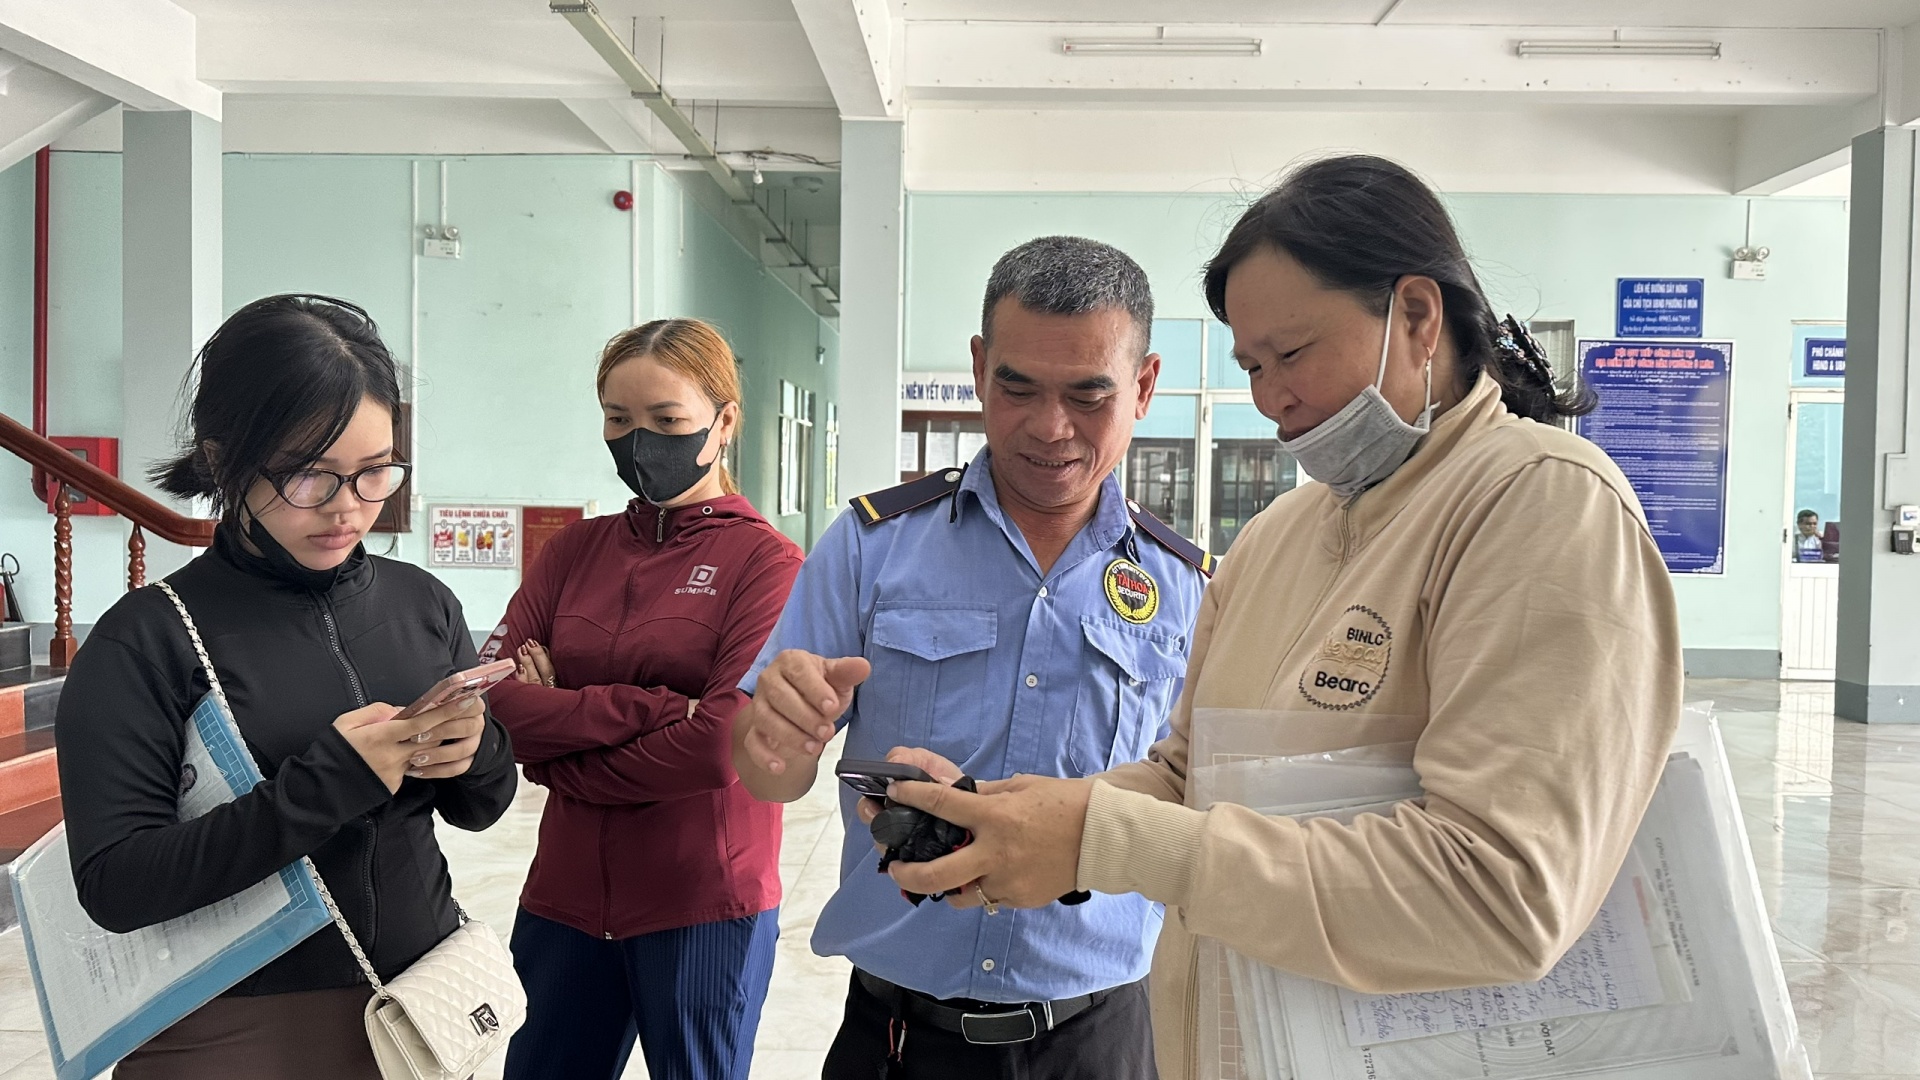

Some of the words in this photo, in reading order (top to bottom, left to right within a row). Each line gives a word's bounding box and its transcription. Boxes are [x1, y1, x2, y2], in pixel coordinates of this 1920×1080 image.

[906, 381, 924, 400] NIÊM
[926, 378, 939, 400] YẾT
[941, 384, 955, 403] QUY
[957, 384, 974, 404] ĐỊNH
[1117, 586, 1147, 602] SECURITY
[1346, 627, 1384, 646] BINLC
[1314, 671, 1370, 694] Bearc
